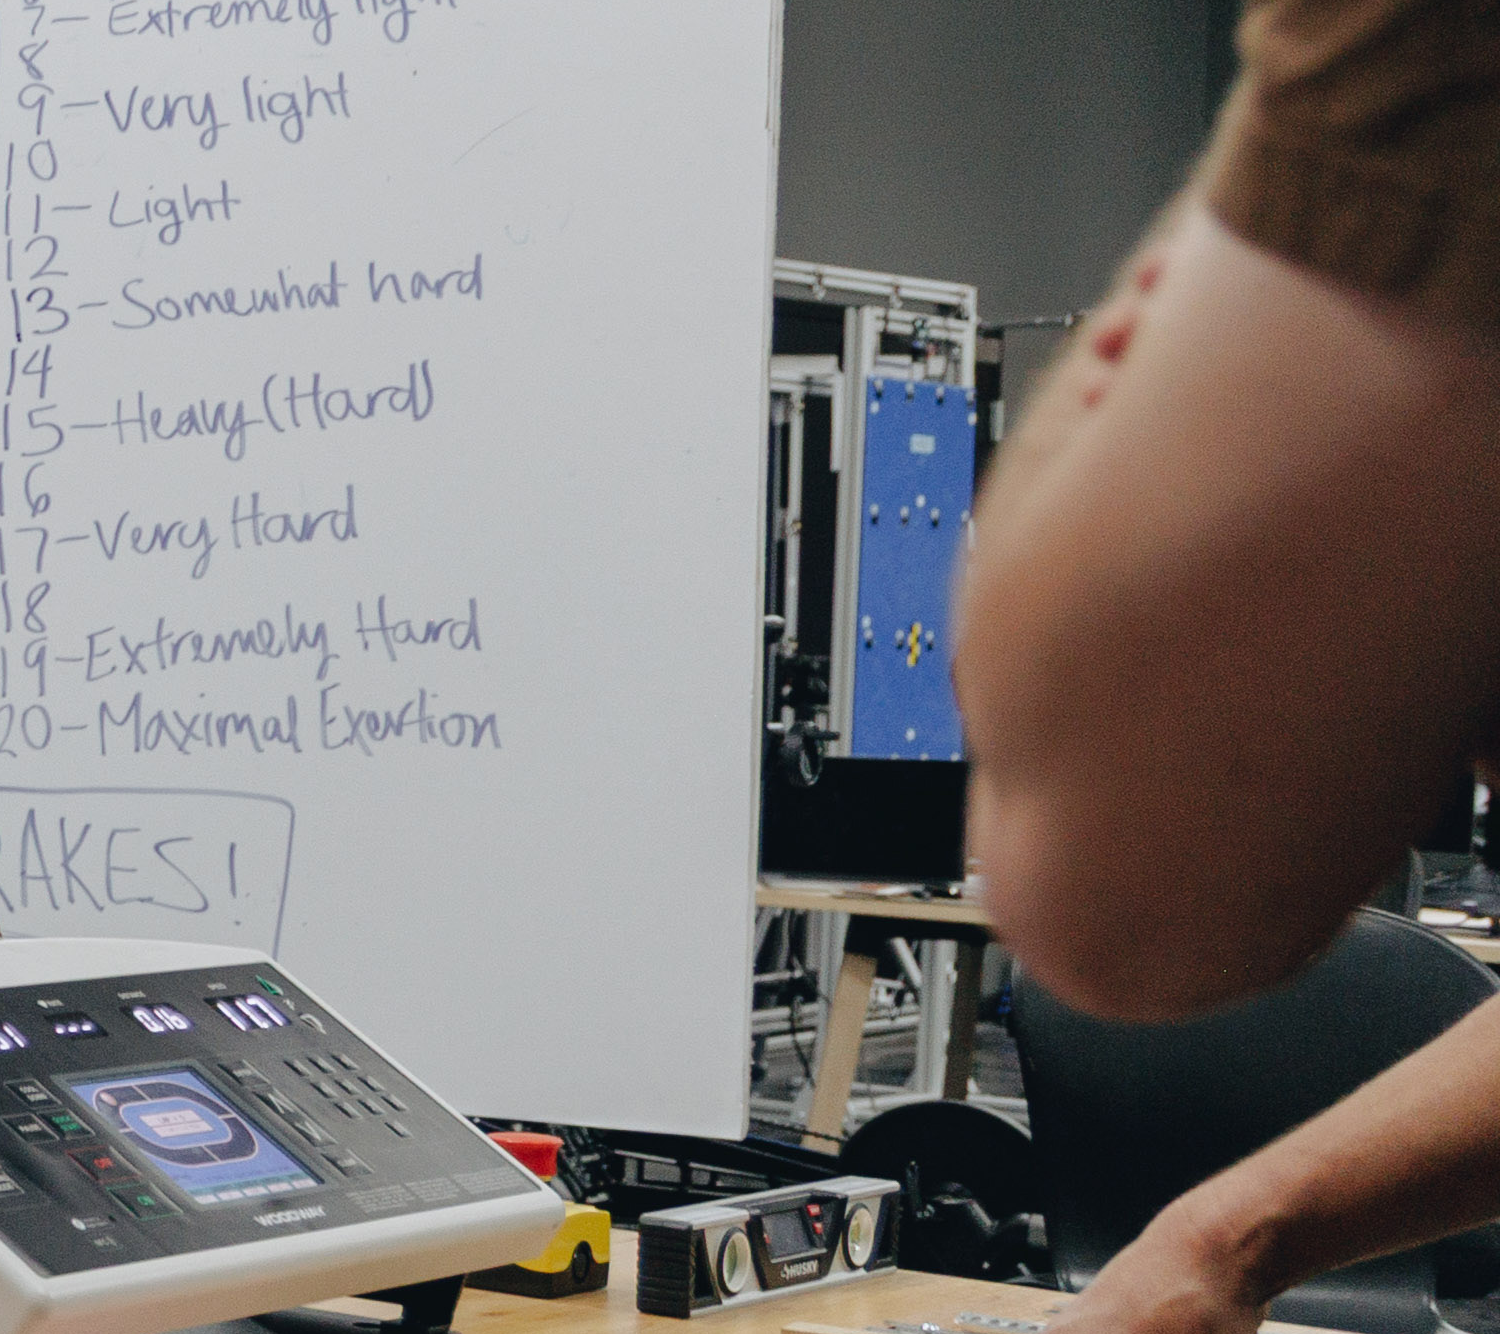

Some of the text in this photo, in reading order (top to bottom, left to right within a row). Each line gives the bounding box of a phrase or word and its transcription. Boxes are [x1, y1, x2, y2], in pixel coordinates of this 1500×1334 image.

[19, 39, 50, 79] 8
[241, 72, 351, 144] light
[5, 139, 58, 192] 10
[5, 235, 69, 281] 12
[368, 252, 485, 304] hard
[6, 344, 53, 399] 14
[231, 483, 359, 550] Hard
[1, 580, 51, 634] 18
[356, 594, 483, 663] Hard
[319, 681, 501, 758] Exertion
